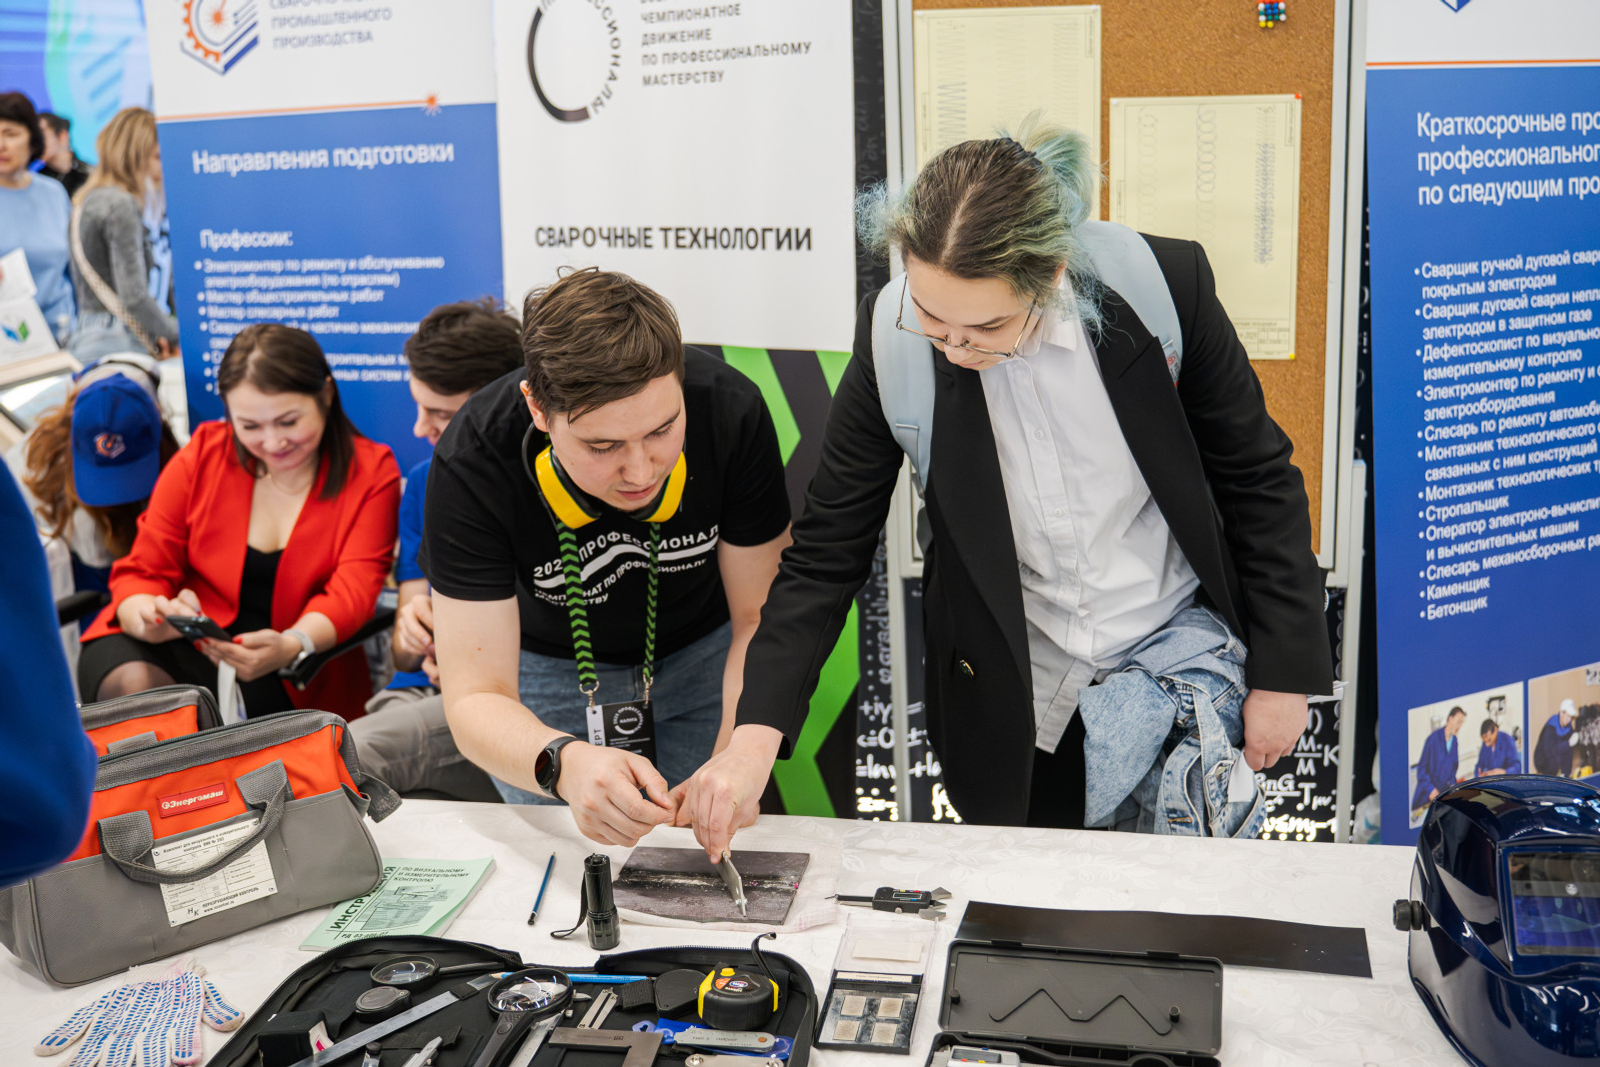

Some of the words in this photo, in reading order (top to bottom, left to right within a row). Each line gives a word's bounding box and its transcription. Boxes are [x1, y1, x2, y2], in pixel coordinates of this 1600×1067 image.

[270, 8, 393, 29] ПРОМЫШЛЕННОГО
[640, 3, 741, 24] ЧЕМПИОНАТНОЕ
[272, 30, 374, 49] ПРОИЗВОДСТВА
[641, 28, 712, 48] ДВИЖЕНИЕ
[641, 53, 659, 66] ПО
[662, 41, 812, 65] ПРОФЕССИОНАЛЬНОМУ
[642, 70, 725, 87] МАСТЕРСТВУ
[1417, 112, 1566, 142] Краткосрочные
[192, 148, 329, 177] Направления
[333, 143, 454, 171] подготовки
[1419, 186, 1443, 205] по
[1449, 178, 1563, 206] следующим
[200, 229, 293, 251] Профессии:
[535, 227, 653, 249] СВАРОЧНЫЕ
[659, 227, 812, 250] ТЕХНОЛОГИИ
[1421, 262, 1479, 280] Сварщик
[1481, 254, 1523, 276] ручной
[1525, 249, 1570, 272] дуговой
[1422, 281, 1486, 300] покрытым
[1488, 273, 1557, 293] электродом
[1422, 302, 1480, 321] Сварщик
[1481, 293, 1528, 316] дуговой
[1530, 292, 1570, 309] сварки
[1422, 320, 1496, 340] электродом
[1498, 318, 1506, 331] в
[1508, 311, 1567, 330] защитном
[1569, 308, 1593, 323] газе
[1423, 337, 1523, 364] Дефектоскопист
[1525, 334, 1540, 348] по
[1424, 356, 1525, 381] измерительному
[1527, 348, 1583, 367] контролю
[1424, 377, 1519, 401] Электромонтер
[1521, 374, 1536, 388] по
[1537, 367, 1586, 389] ремонту
[1587, 366, 1595, 378] и
[1424, 390, 1555, 421] электрооборудования
[1424, 422, 1478, 442] Слесарь
[1481, 419, 1496, 433] по
[1498, 411, 1547, 434] ремонту
[1425, 440, 1494, 462] Монтажник
[1496, 422, 1596, 451] технологического
[1425, 460, 1491, 482] связанных
[1493, 458, 1500, 471] с
[1502, 453, 1526, 469] ним
[1528, 438, 1598, 462] конструкций
[1425, 478, 1495, 502] Монтажник
[1496, 461, 1591, 489] технологических
[1425, 495, 1509, 523] Стропальщик
[1425, 519, 1486, 541] Оператор
[1426, 548, 1435, 561] и
[1437, 528, 1538, 559] вычислительных
[1540, 520, 1579, 538] машин
[1426, 560, 1480, 581] Слесарь
[1482, 537, 1586, 570] механосборочных
[603, 573, 617, 588] ПО
[1427, 576, 1490, 601] Каменщик
[1427, 596, 1488, 620] Бетонщик
[169, 790, 224, 809] Энергомаш
